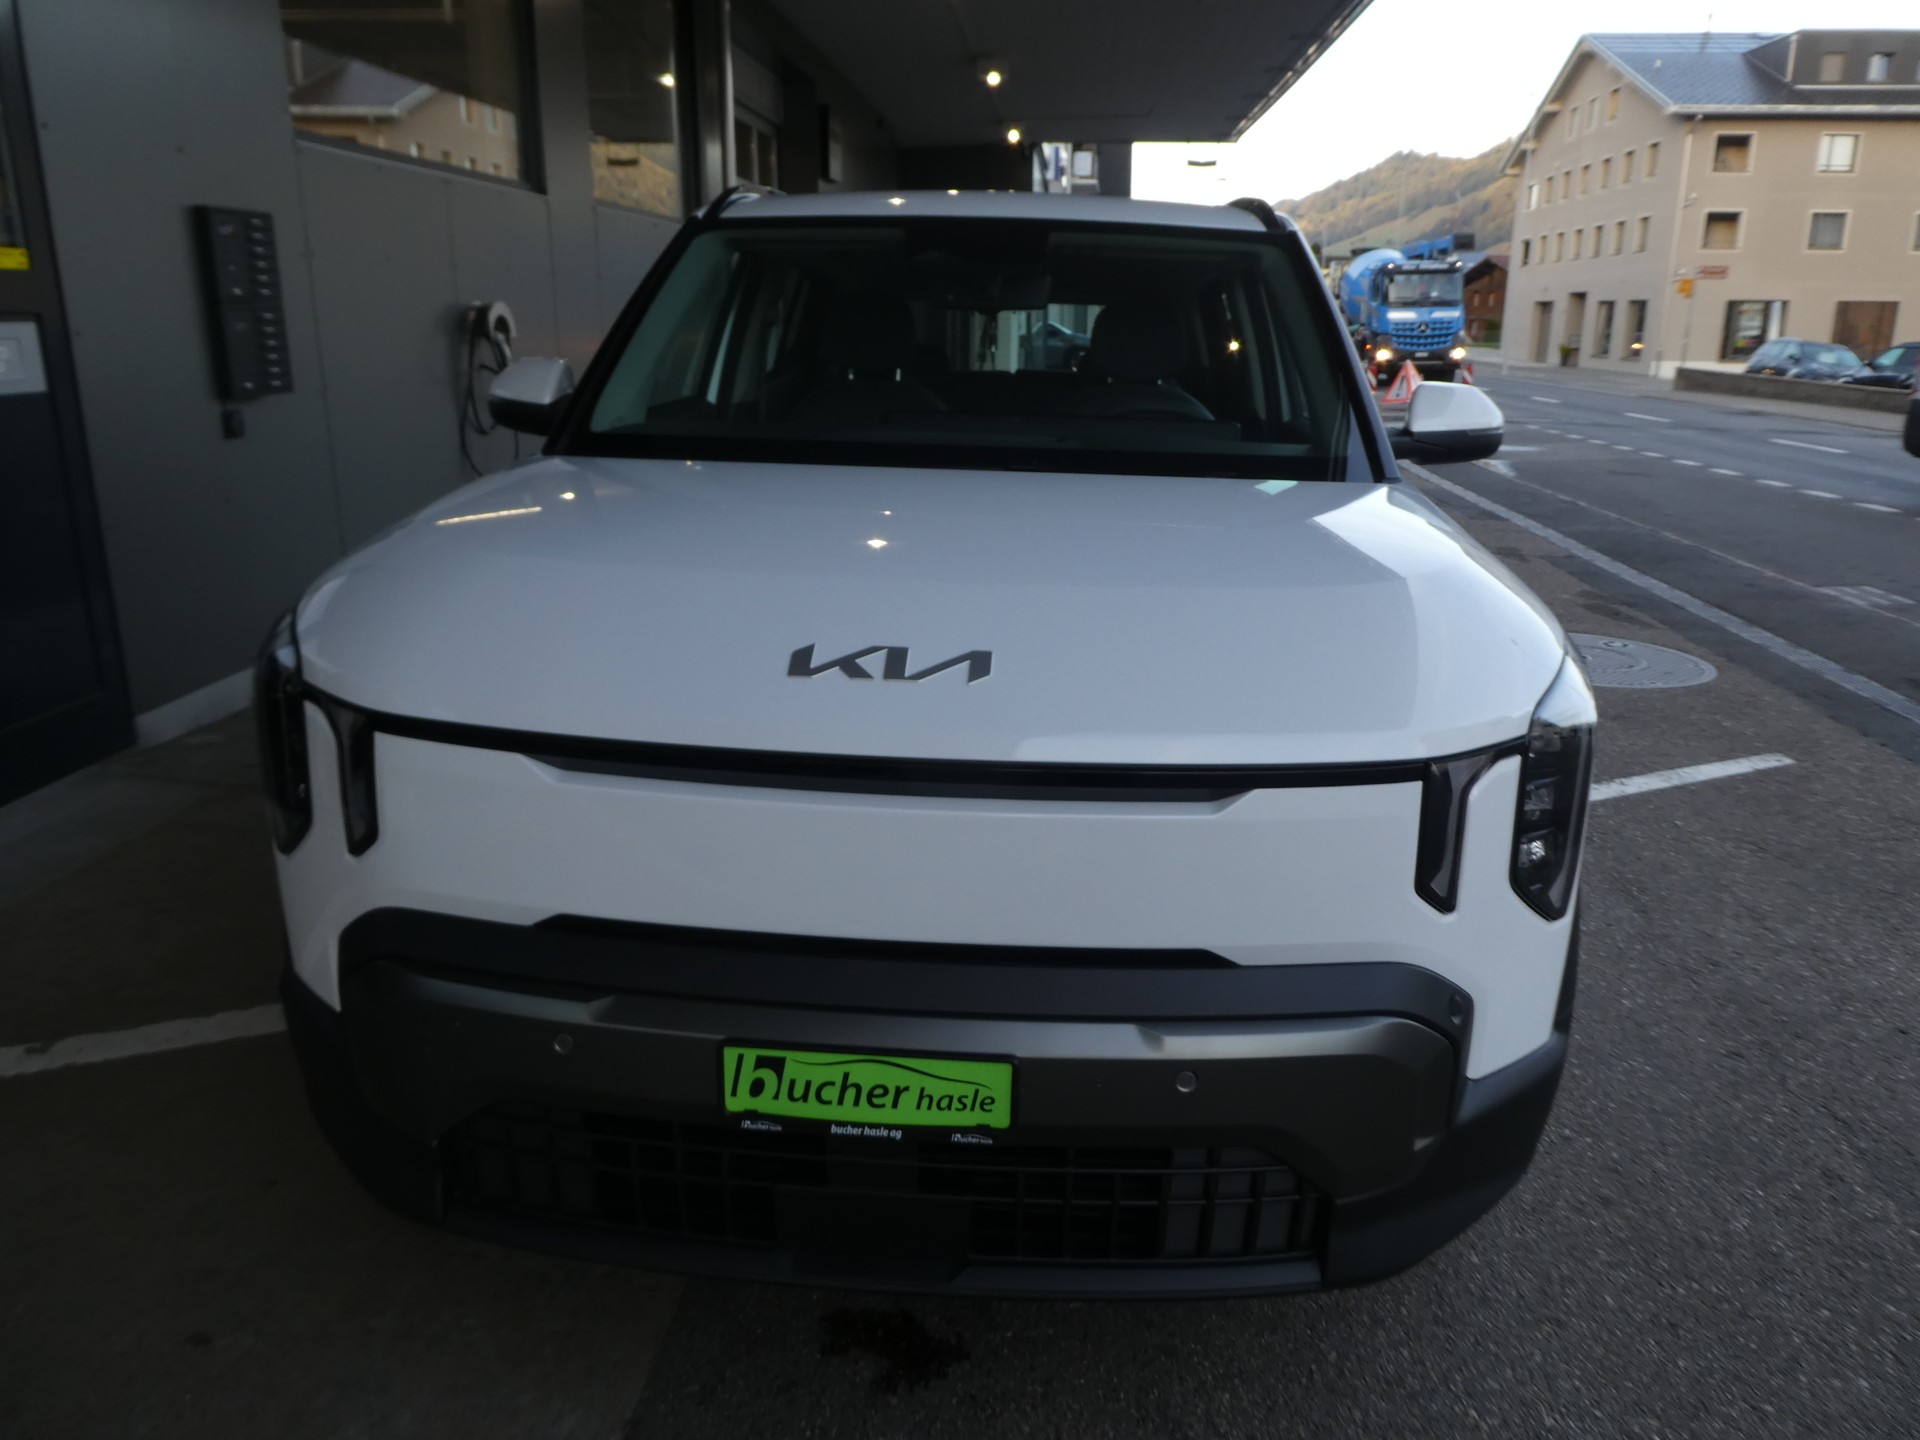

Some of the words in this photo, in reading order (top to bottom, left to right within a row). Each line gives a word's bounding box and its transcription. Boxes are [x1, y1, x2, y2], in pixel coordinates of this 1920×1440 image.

[787, 643, 993, 686] KIA
[915, 1086, 996, 1113] hasle
[831, 1123, 863, 1135] bucher
[864, 1125, 889, 1137] hasle
[889, 1129, 903, 1141] ag
